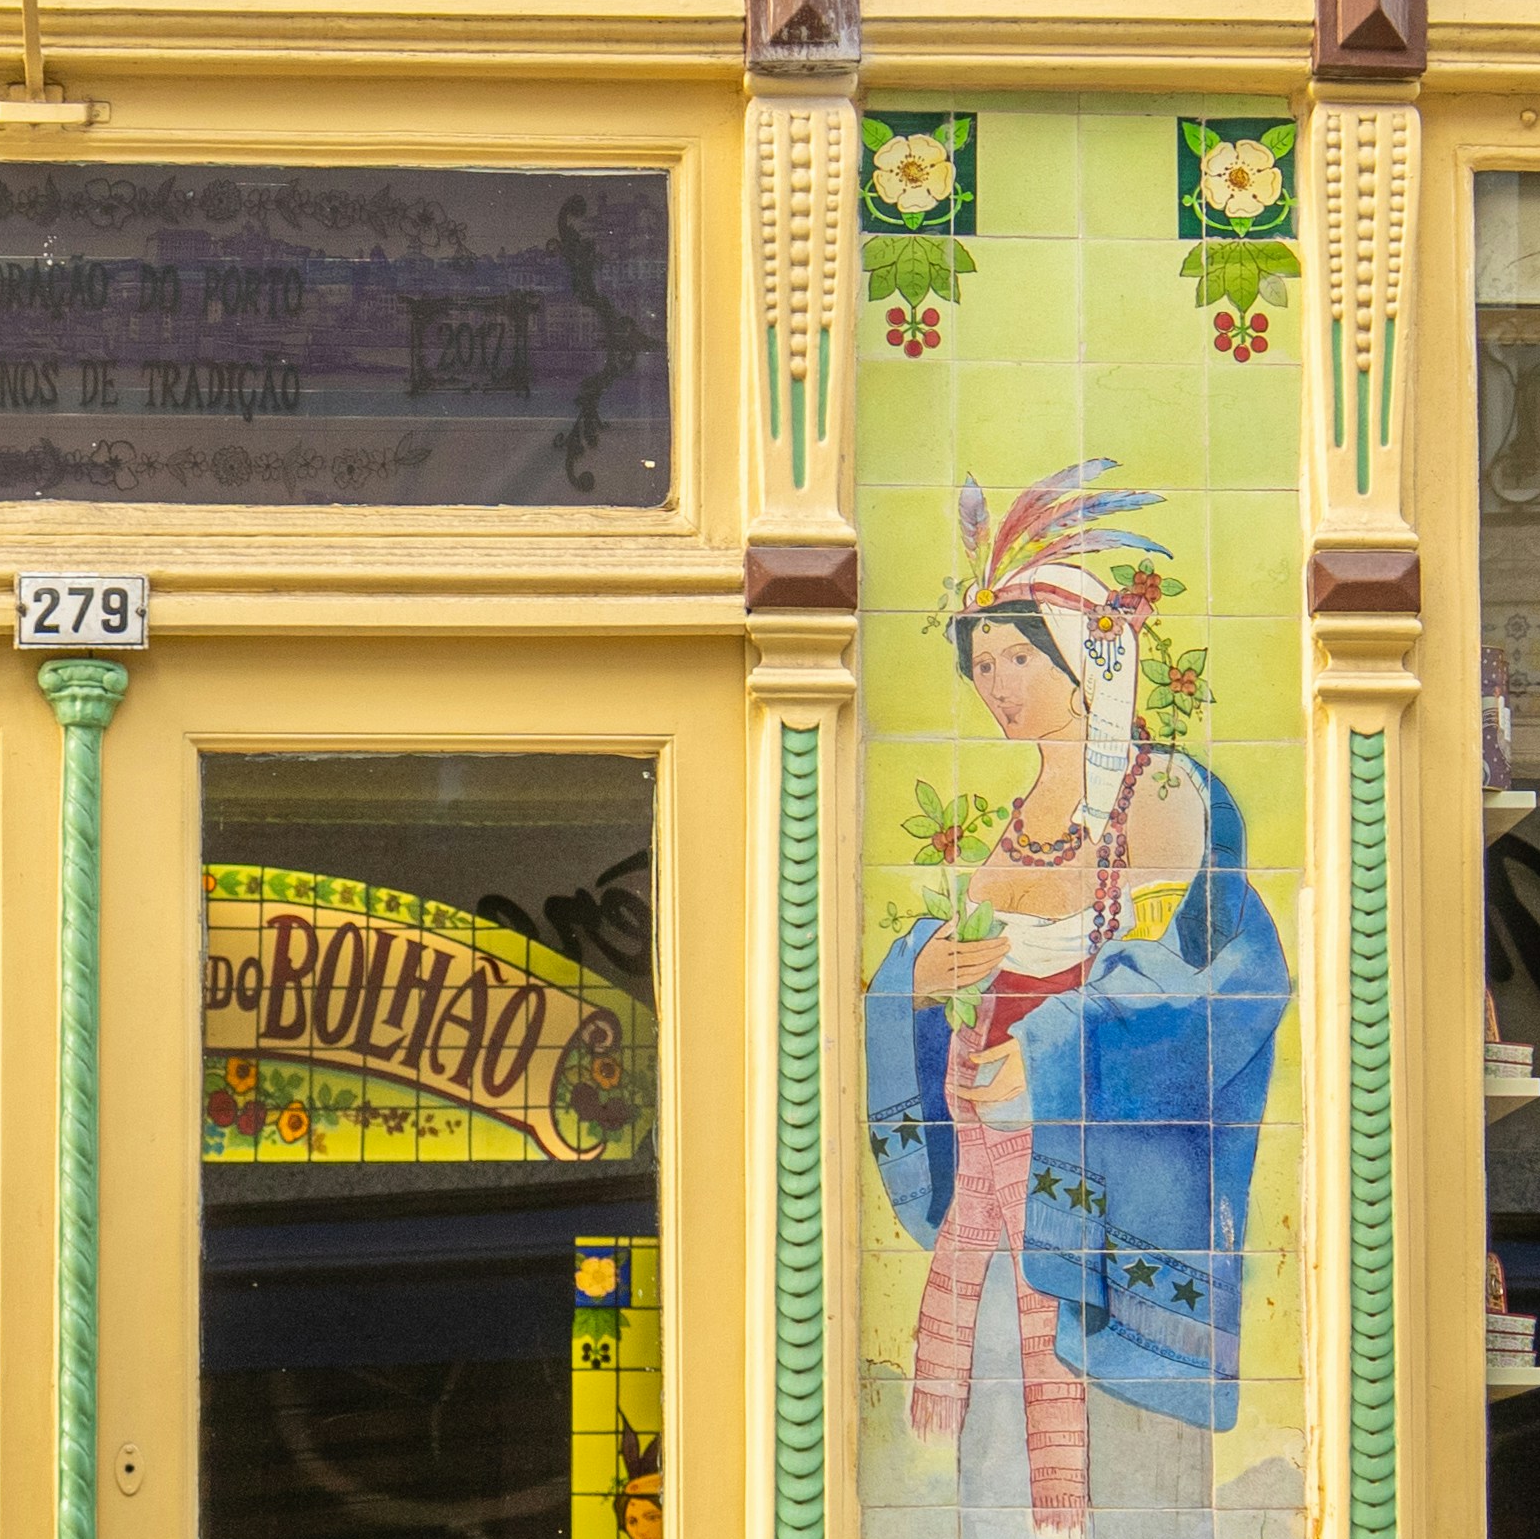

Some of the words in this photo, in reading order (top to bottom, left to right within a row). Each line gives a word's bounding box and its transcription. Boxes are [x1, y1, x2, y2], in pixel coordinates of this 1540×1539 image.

[139, 262, 181, 316] DO
[203, 265, 305, 318] PORTO
[435, 322, 507, 375] 2017
[79, 359, 118, 408] DE
[141, 354, 300, 423] TRADIÇÃO
[32, 586, 129, 634] 279
[259, 914, 546, 1098] BOLHÃO
